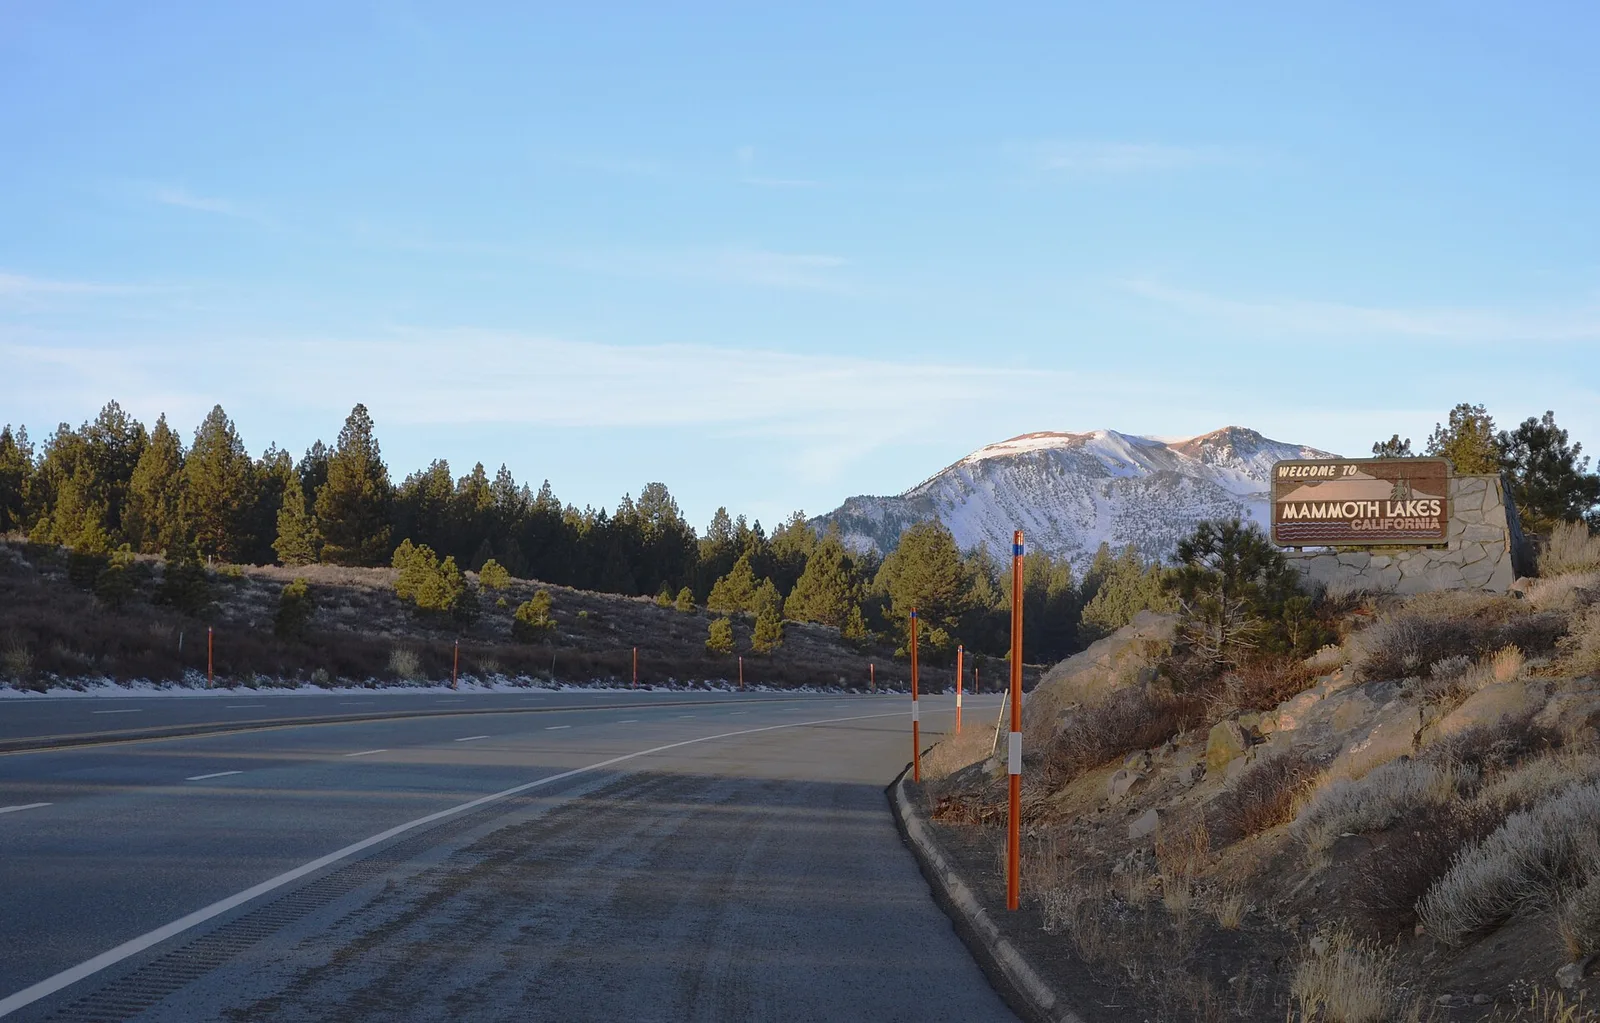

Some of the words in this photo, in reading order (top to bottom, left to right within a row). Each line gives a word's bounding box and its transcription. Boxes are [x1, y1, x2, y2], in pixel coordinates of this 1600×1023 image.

[1278, 465, 1336, 477] WELCOME
[1342, 465, 1357, 476] TO
[1282, 501, 1380, 519] MAMMOTH
[1386, 500, 1442, 517] LAKES
[1351, 518, 1441, 531] CALIFORNIA
